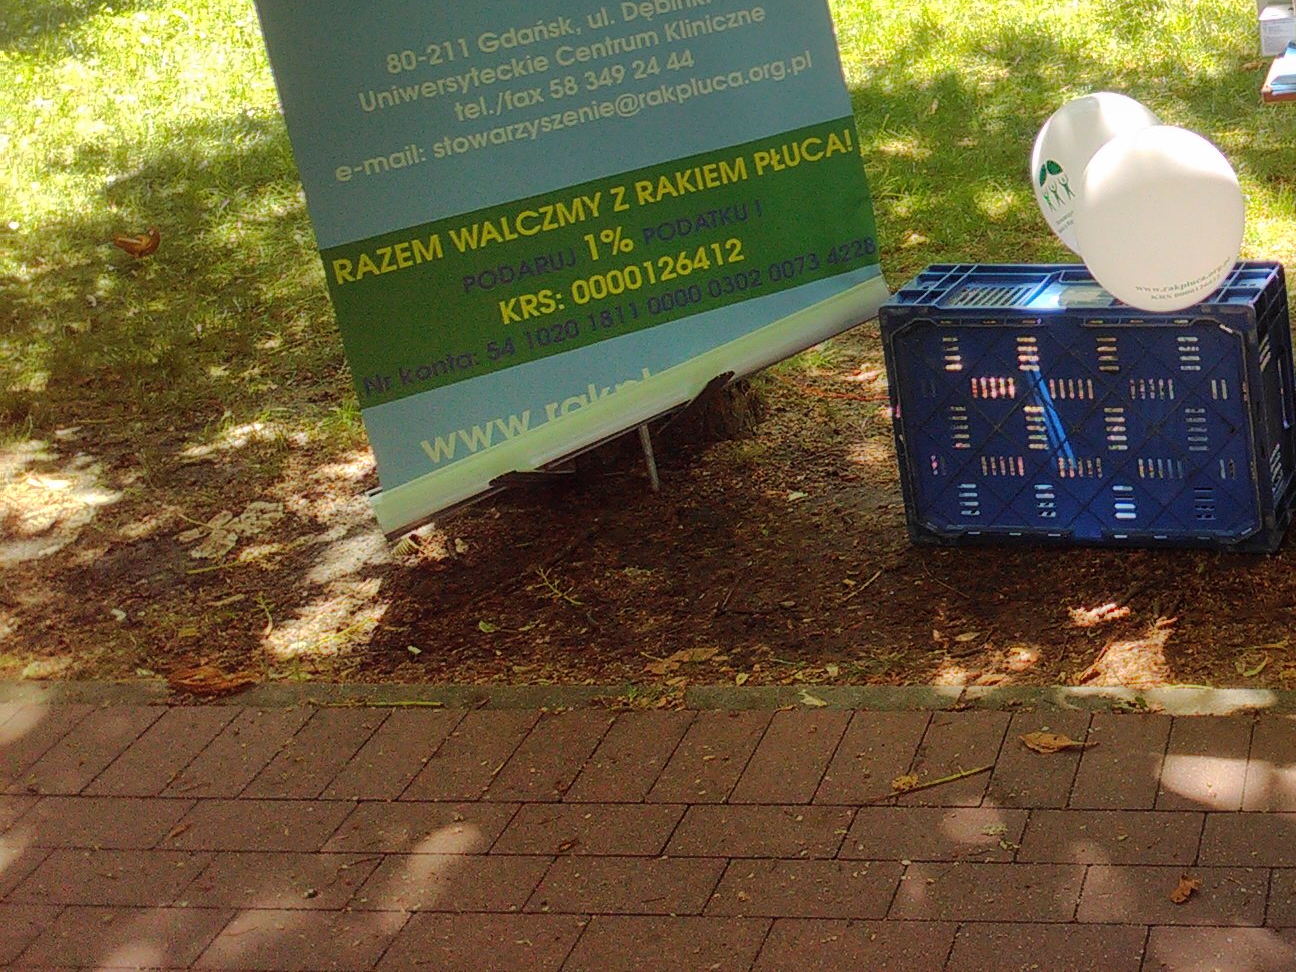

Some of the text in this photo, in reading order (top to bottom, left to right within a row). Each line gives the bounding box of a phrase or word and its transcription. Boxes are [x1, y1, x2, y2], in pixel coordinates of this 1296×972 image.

[359, 7, 766, 112] Uniwersyteckie Centrum Kliniczne
[386, 37, 470, 74] 80-211
[477, 16, 582, 53] Gdańsk,
[587, 8, 616, 28] ul.
[454, 50, 695, 121] tel./fax 58 349 24 44
[335, 50, 812, 181] e-mail: stowarzyszenie@rakpluca.org.pl
[332, 129, 853, 284] RAZEM WALCZMY Z RAKIEM PŁUCA!
[463, 248, 577, 292] PODARUJ
[584, 227, 634, 260] 1%
[643, 202, 748, 245] PODATKU
[362, 374, 393, 396] Nr
[399, 349, 480, 383] konta:
[525, 319, 580, 348] 1020
[648, 285, 701, 314] 0000
[707, 269, 762, 298] 0302
[768, 252, 820, 281] 0073
[500, 238, 744, 325] KRS: 0000126412
[420, 367, 652, 464] wwwrak
